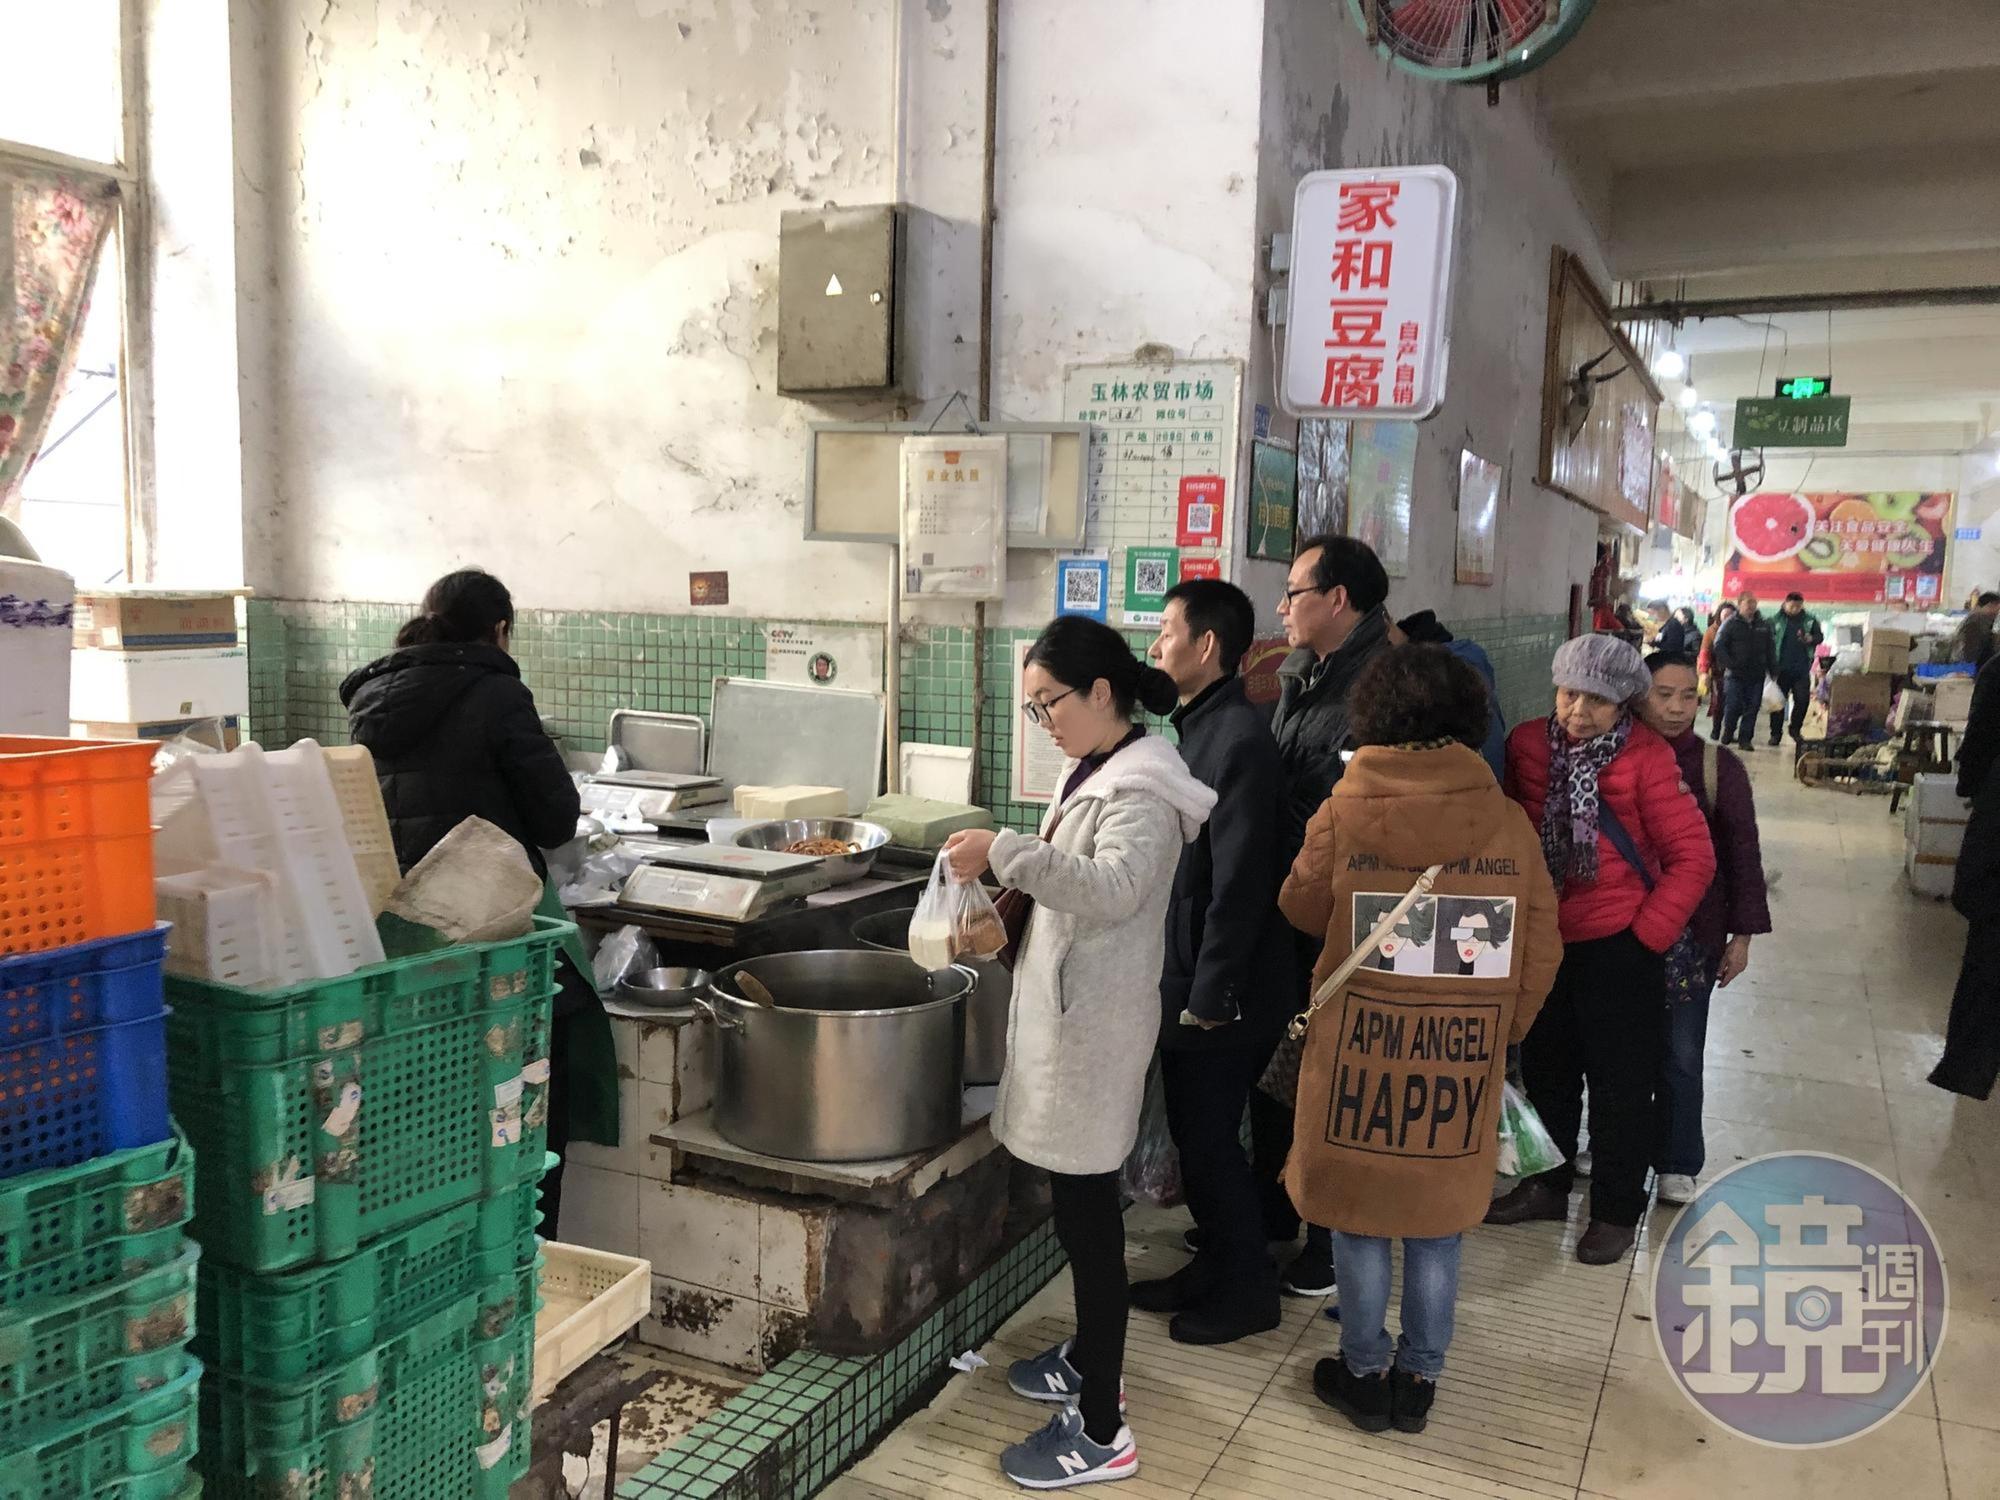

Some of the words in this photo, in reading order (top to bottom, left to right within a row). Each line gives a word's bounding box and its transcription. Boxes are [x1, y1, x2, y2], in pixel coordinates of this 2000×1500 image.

[1320, 182, 1400, 410] 家和豆腐
[1393, 320, 1419, 405] 自产自销
[1091, 379, 1214, 402] 玉林农贸市场
[1778, 415, 1843, 434] 豆制品区
[1814, 520, 1908, 533] 关注食品安全
[1346, 853, 1380, 871] APM
[1474, 857, 1520, 876] ANGEL
[1347, 1007, 1405, 1060] APM
[1408, 1015, 1489, 1063] ANGEL
[1333, 1063, 1486, 1149] HAPPY
[1044, 1372, 1069, 1392] N
[1056, 1450, 1089, 1476] N
